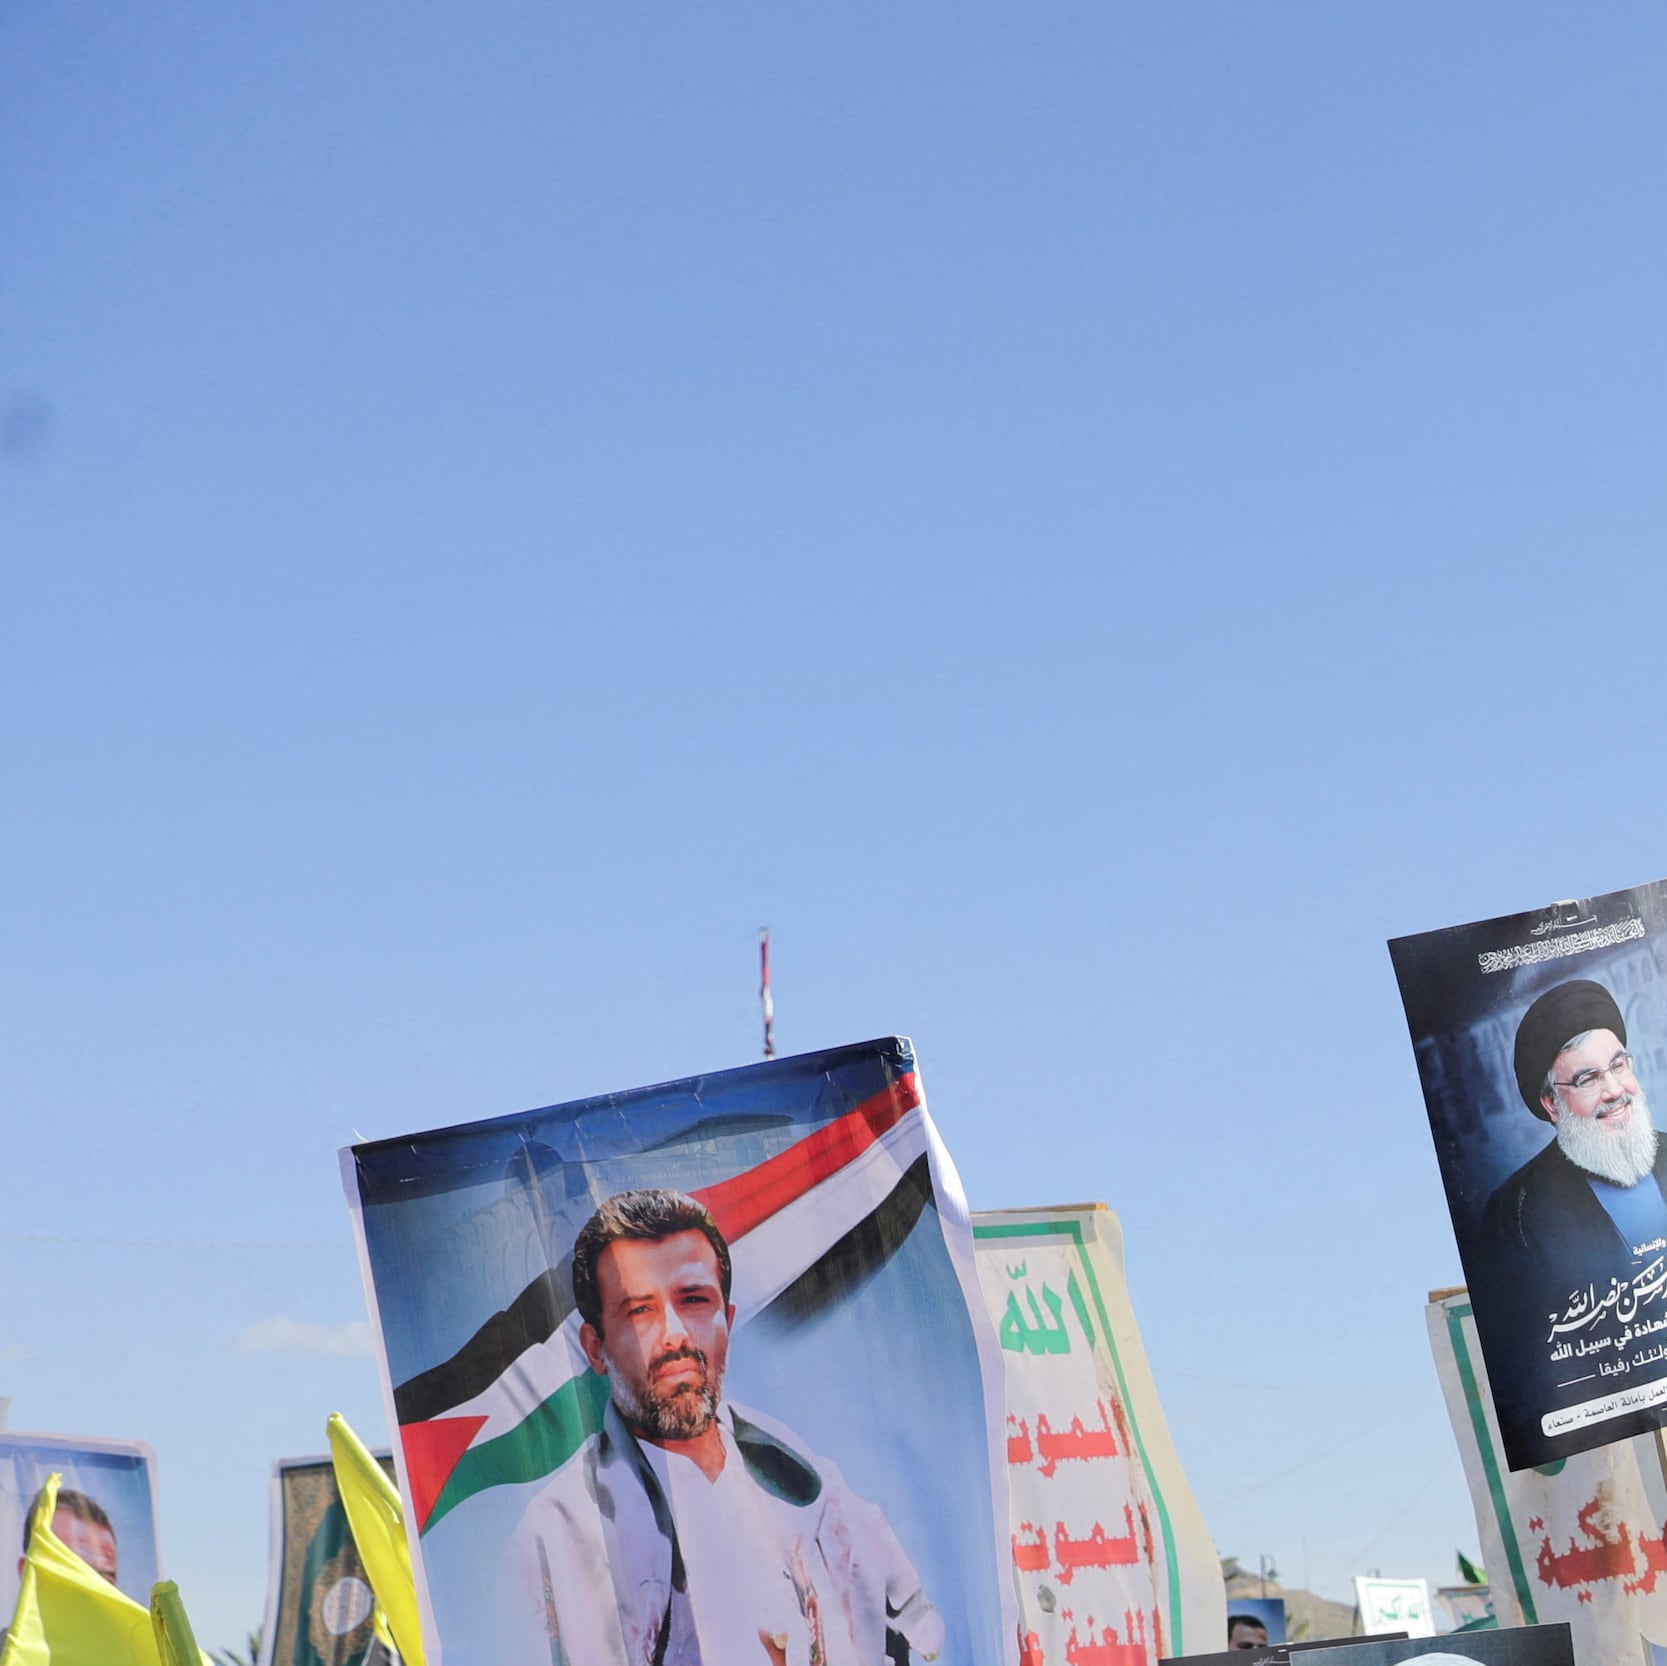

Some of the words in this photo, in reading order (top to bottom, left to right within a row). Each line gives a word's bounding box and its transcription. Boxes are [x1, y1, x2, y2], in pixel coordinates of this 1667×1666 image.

[1000, 1258, 1096, 1356] الله
[1574, 1336, 1611, 1358] سبيل
[1613, 1326, 1634, 1350] في
[1549, 1342, 1573, 1362] الله
[1598, 1358, 1631, 1378] رفيقا
